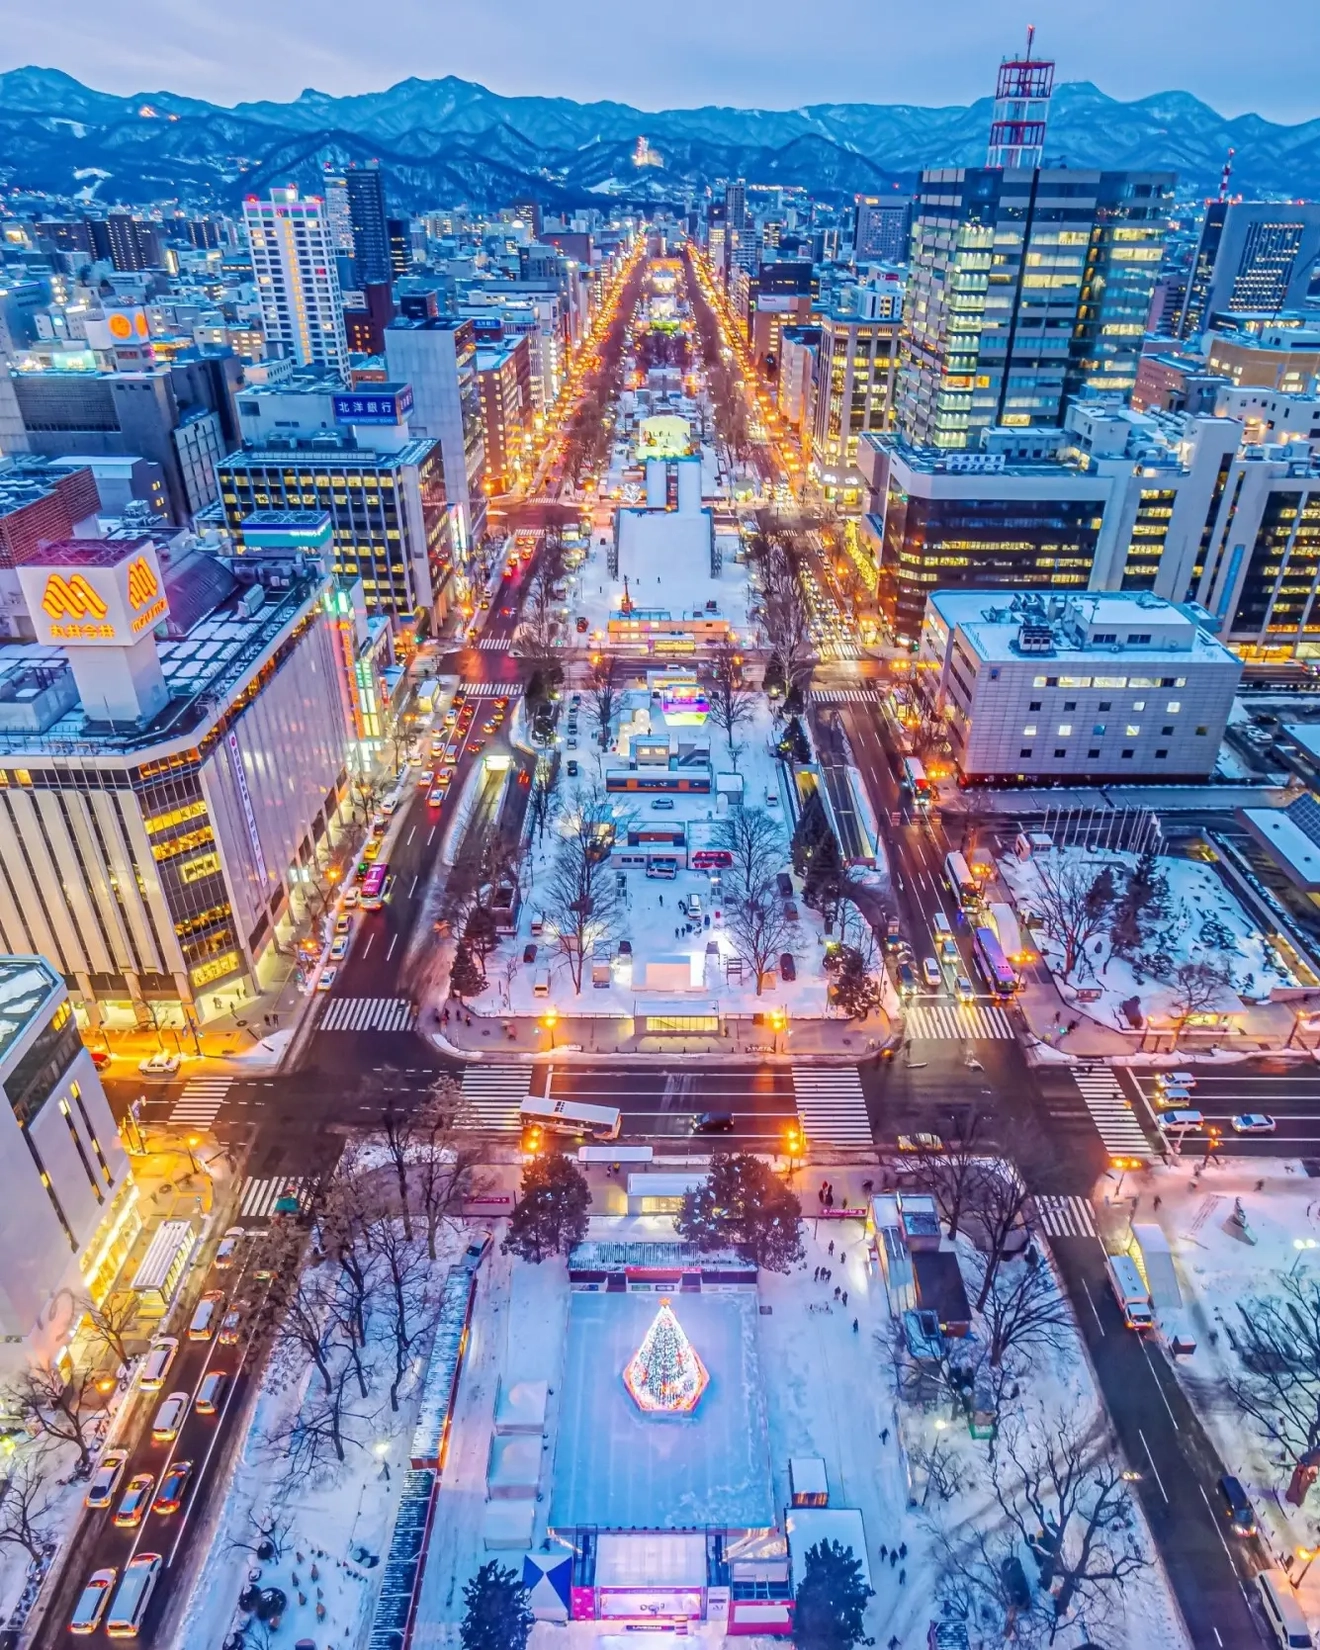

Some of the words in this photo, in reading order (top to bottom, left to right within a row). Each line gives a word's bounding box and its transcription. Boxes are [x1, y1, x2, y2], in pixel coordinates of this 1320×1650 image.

[338, 401, 392, 413] 北洋銀行
[50, 623, 115, 639] 丸井今井
